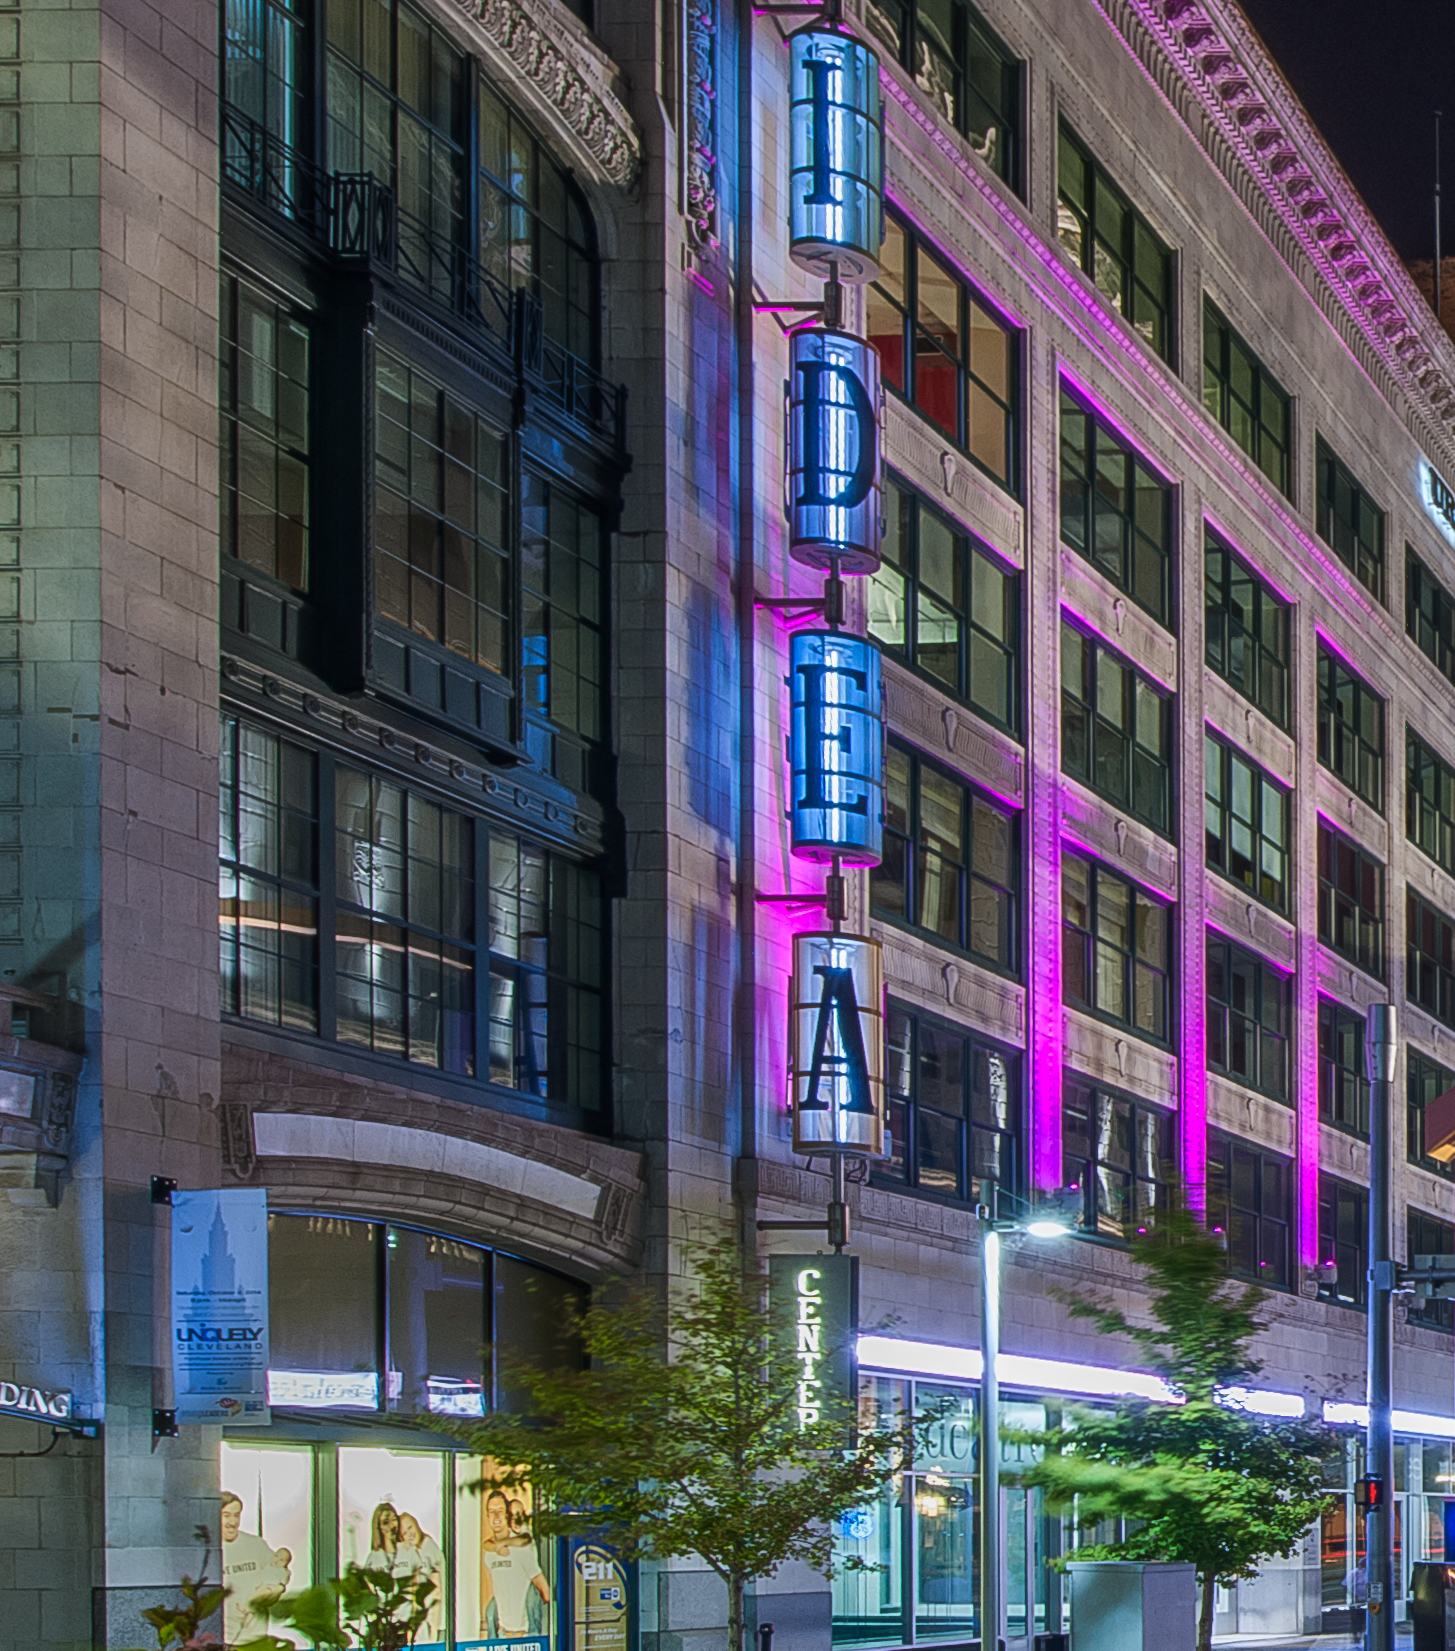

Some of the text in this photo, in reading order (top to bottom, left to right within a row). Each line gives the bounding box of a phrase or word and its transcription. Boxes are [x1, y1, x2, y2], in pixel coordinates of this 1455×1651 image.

[796, 58, 875, 1113] IDEA
[177, 1342, 263, 1351] CLEVELAND
[0, 1382, 69, 1417] DING
[232, 1561, 257, 1574] UNITED
[583, 1561, 614, 1580] 211
